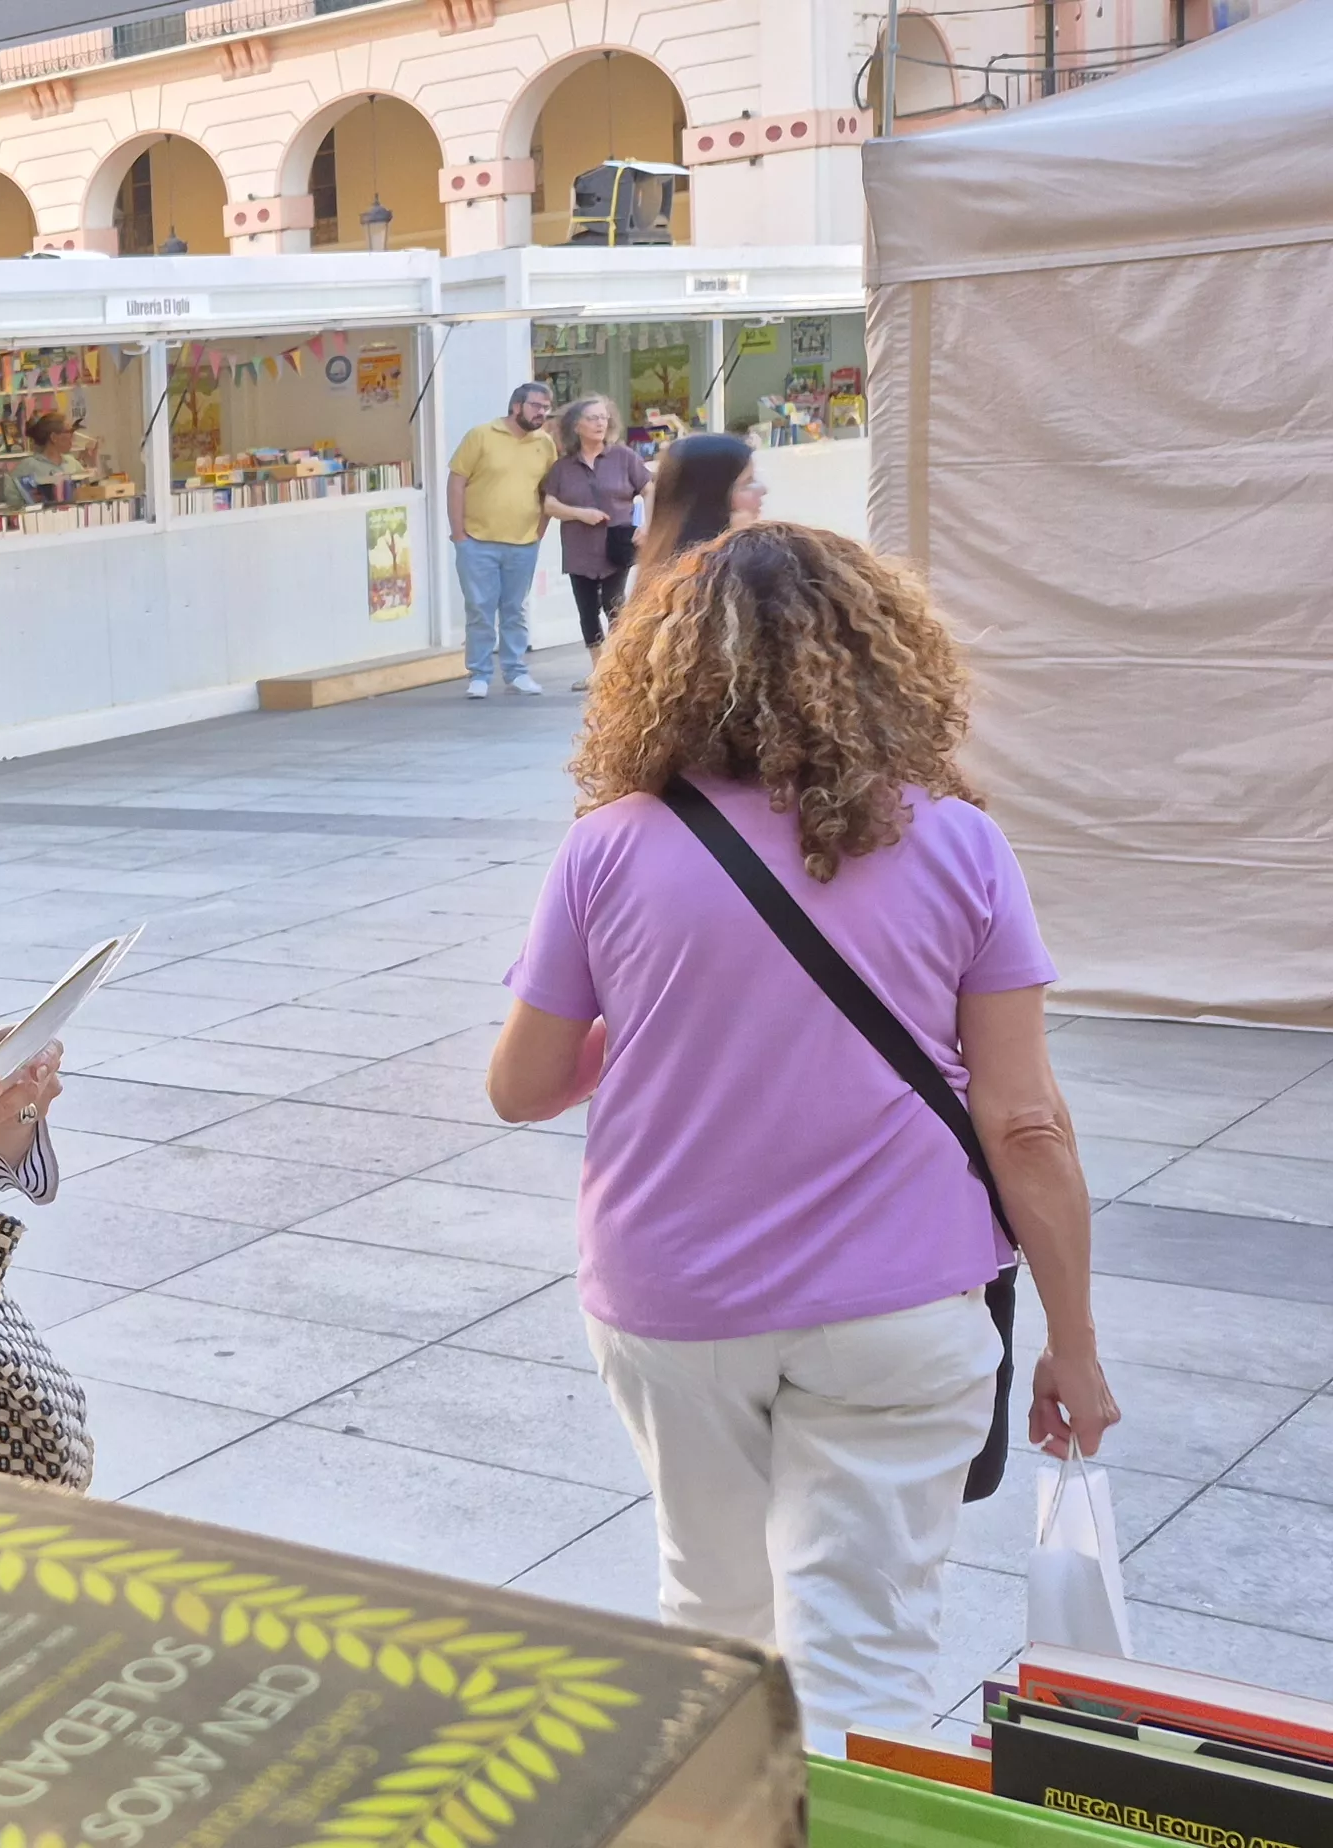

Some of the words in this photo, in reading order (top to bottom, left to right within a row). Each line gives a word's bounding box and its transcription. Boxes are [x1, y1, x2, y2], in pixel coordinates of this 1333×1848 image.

[126, 299, 162, 316] Librería
[163, 298, 171, 315] El
[172, 296, 190, 316] Iglú
[123, 1716, 183, 1752] DE
[200, 1664, 321, 1746] CIEN
[81, 1736, 227, 1847] AÑOS
[1044, 1787, 1122, 1824] ¡LLEGA
[1123, 1807, 1156, 1833] EL
[1156, 1814, 1246, 1848] EQUIPO
